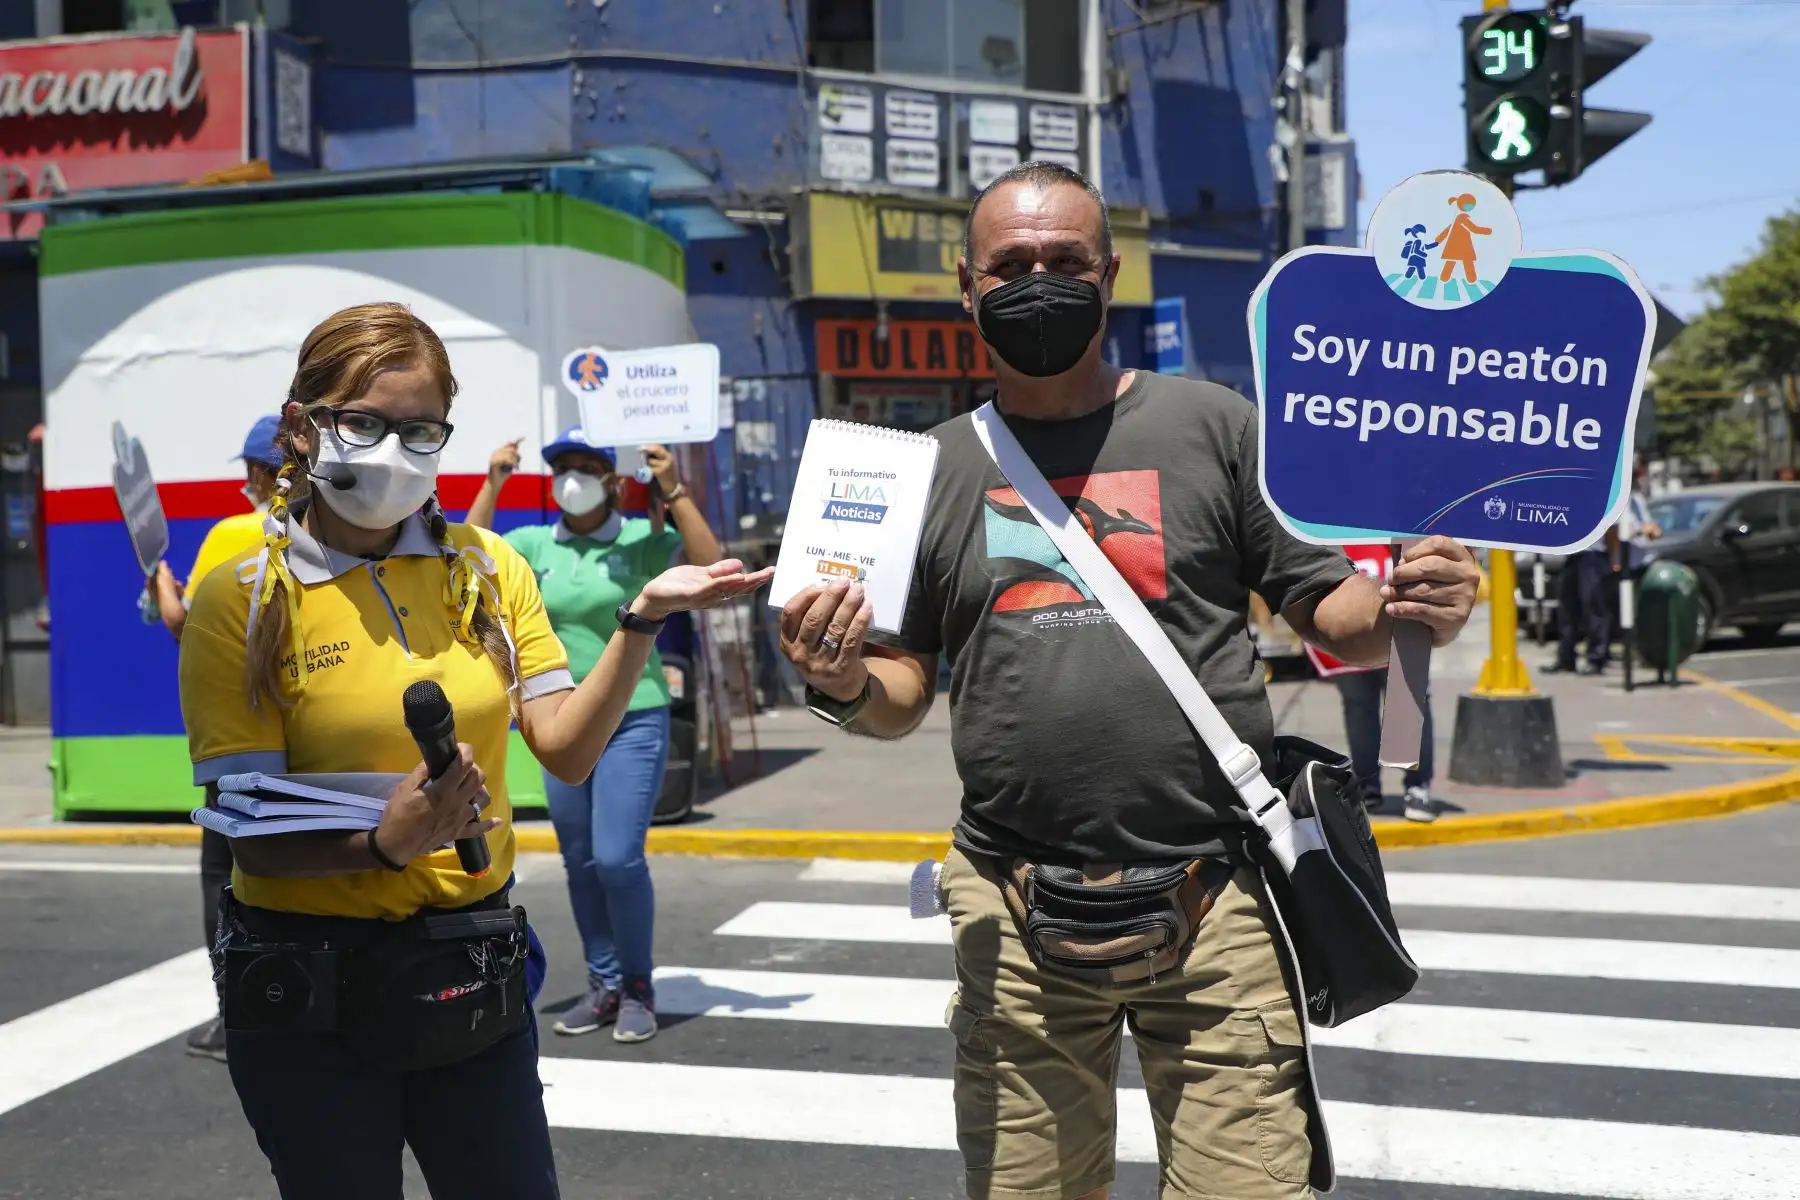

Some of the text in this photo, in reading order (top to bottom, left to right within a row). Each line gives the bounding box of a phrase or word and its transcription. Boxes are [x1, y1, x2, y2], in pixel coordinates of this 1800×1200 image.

[1484, 29, 1533, 75] 34
[1291, 324, 1607, 386] Soy un peatón
[626, 363, 678, 380] Utiliza
[616, 383, 689, 399] el crucero
[623, 401, 690, 419] peatonal
[1283, 391, 1601, 450] responsable
[828, 468, 897, 480] Tu informativo
[830, 482, 886, 502] LIMA
[830, 505, 882, 521] Noticias
[1518, 502, 1561, 511] MUNICIPALIDAD
[1517, 508, 1568, 525] LIMA
[806, 546, 826, 557] LUN
[833, 551, 852, 561] MIE
[860, 556, 876, 566] VIE
[290, 655, 345, 678] UBANA
